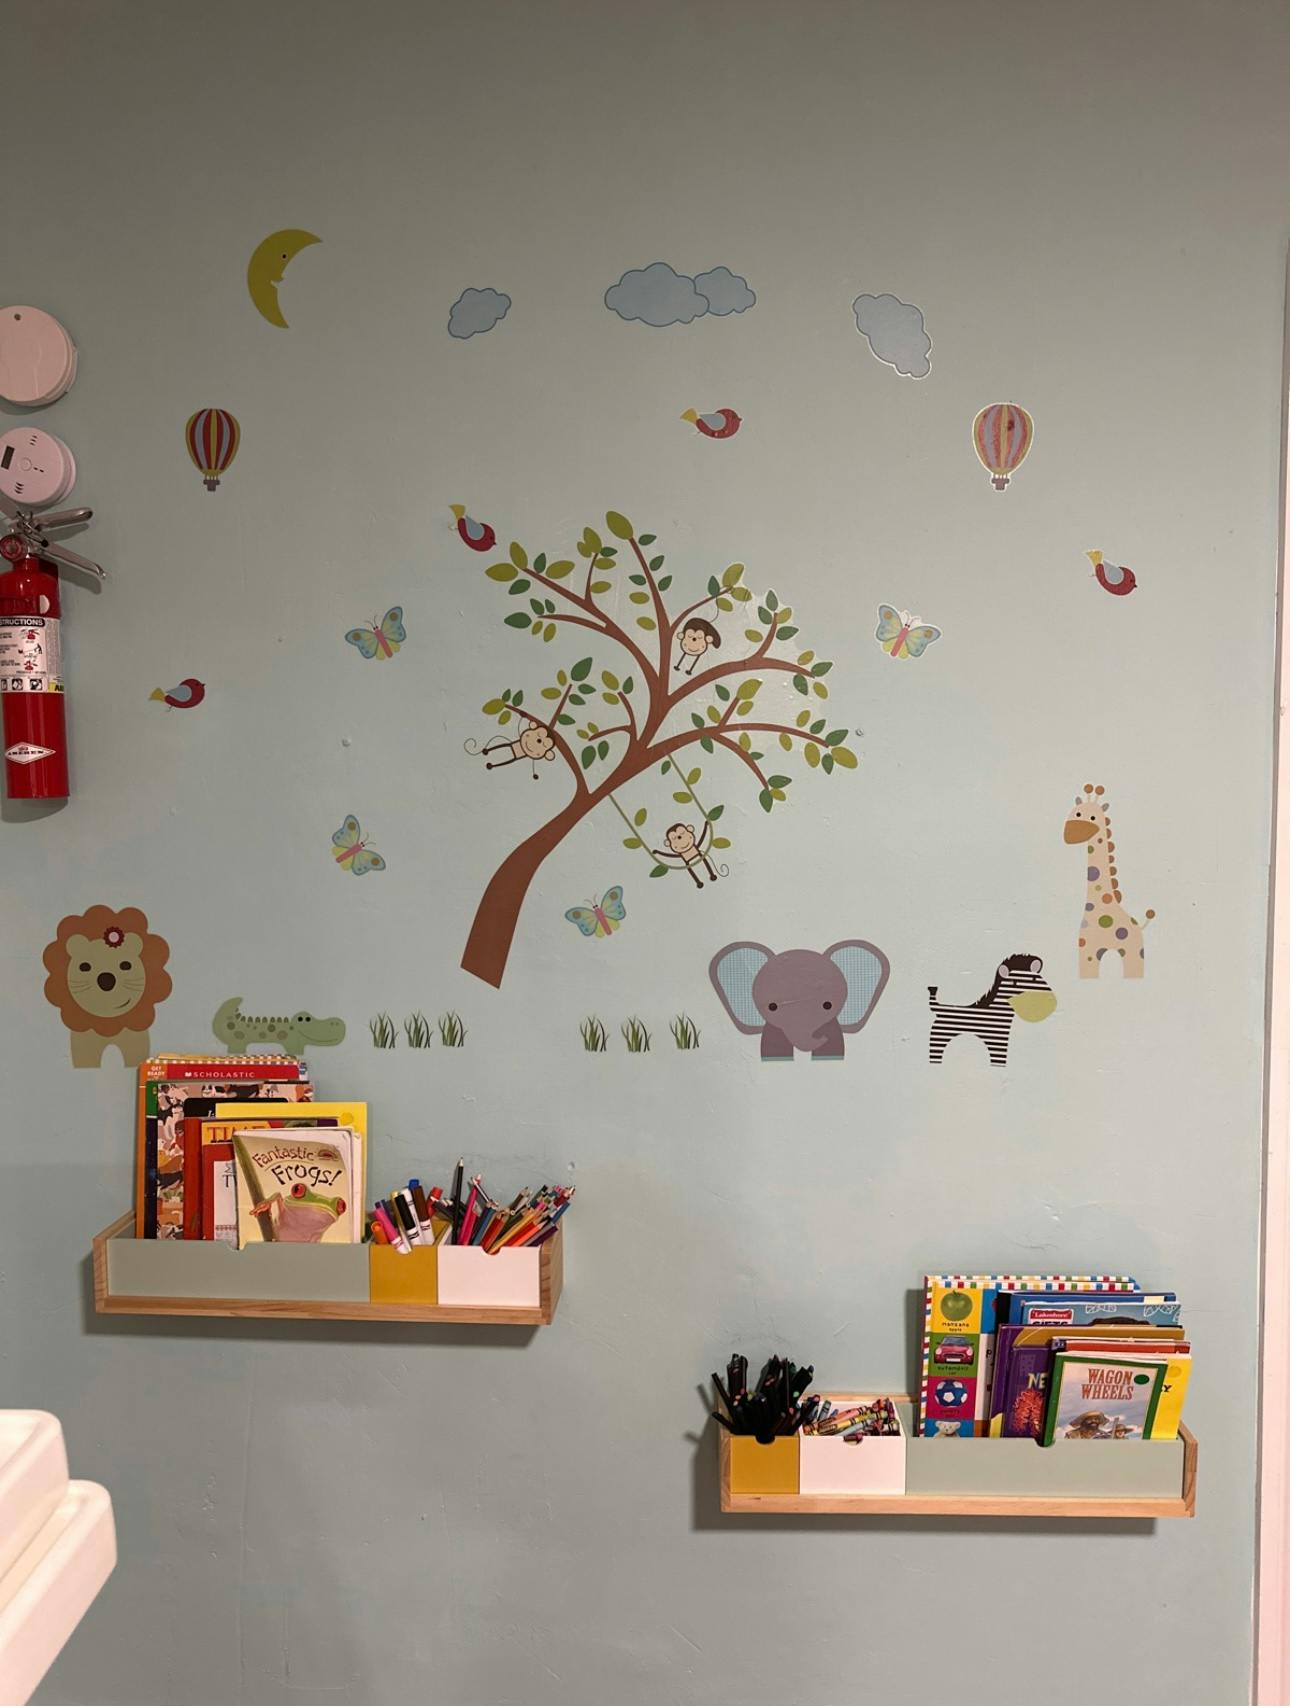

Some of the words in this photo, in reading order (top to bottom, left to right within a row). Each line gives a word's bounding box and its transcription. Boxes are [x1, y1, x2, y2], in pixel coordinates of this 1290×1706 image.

[252, 1145, 314, 1168] Fantastic
[271, 1164, 342, 1187] Frogs!
[1088, 1368, 1134, 1385] WAGON
[1081, 1383, 1134, 1400] WHEELS
